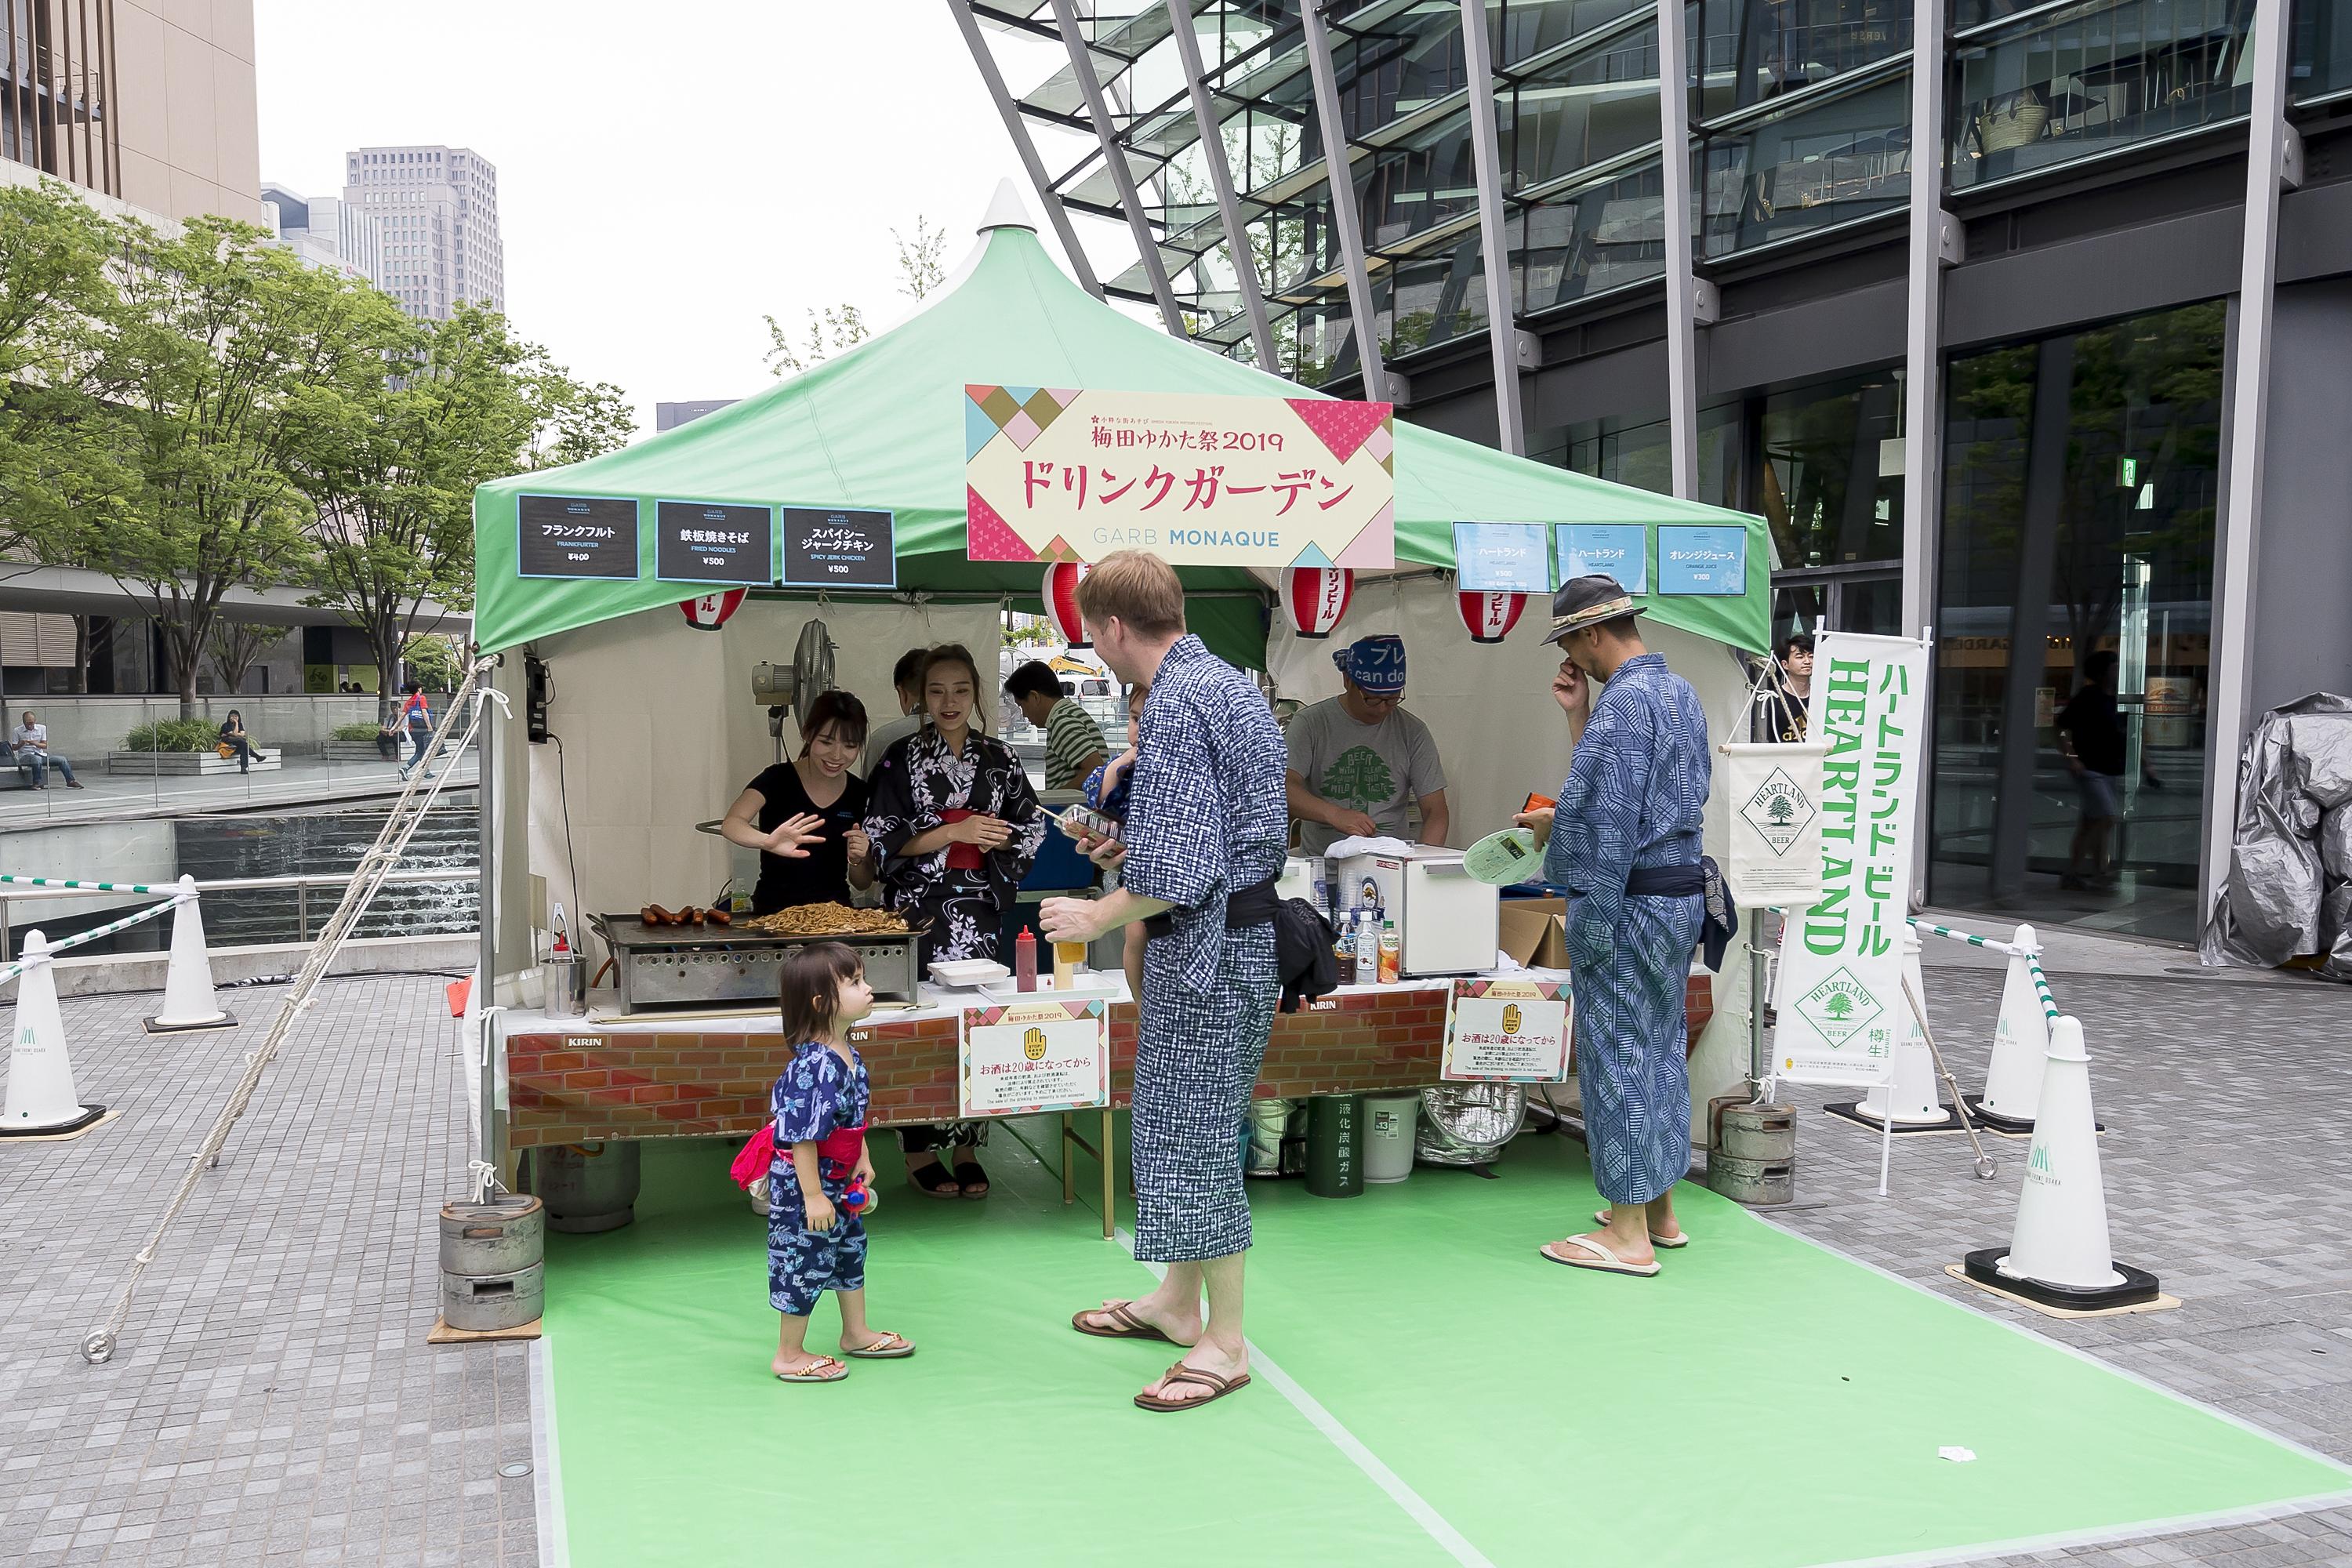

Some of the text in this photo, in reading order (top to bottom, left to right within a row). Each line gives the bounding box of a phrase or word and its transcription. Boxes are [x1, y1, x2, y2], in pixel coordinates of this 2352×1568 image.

[1091, 425, 1284, 452] 梅田ゆかた祭2019
[1022, 460, 1355, 517] ドリンクガーデン
[542, 524, 616, 539] フランクフルト
[679, 528, 750, 544] 鉄板焼きそば
[811, 528, 866, 540] スパイシー
[1092, 527, 1279, 548] GARB MONAQUE
[801, 538, 874, 552] ジャークチキン
[1479, 546, 1526, 558] ハートランド
[567, 552, 590, 561] ¥400
[1578, 548, 1625, 559] ハートランド
[1668, 550, 1735, 561] オレンジジュース
[702, 557, 725, 566] ¥500
[828, 564, 849, 574] ¥500
[700, 593, 716, 612] ール
[1355, 668, 1404, 684] can do
[1347, 750, 1374, 766] BEER
[1330, 783, 1351, 794] MILD
[1754, 782, 1805, 809] HEARTLAND
[1809, 981, 1871, 1007] HEARTLAND
[1309, 1000, 1337, 1011] KIRIN
[1007, 1012, 1062, 1023] 梅田ゆかた祭2019
[1461, 1033, 1556, 1046] お酒は20歳になってから
[1826, 1029, 1848, 1038] BEER
[568, 1037, 603, 1047] KIRIN
[1867, 1028, 1885, 1058] 樽生
[1883, 1029, 1892, 1058] tarunama
[979, 1057, 1091, 1076] お酒は20歳になってから
[1338, 1102, 1352, 1188] 液化炭酸ガス
